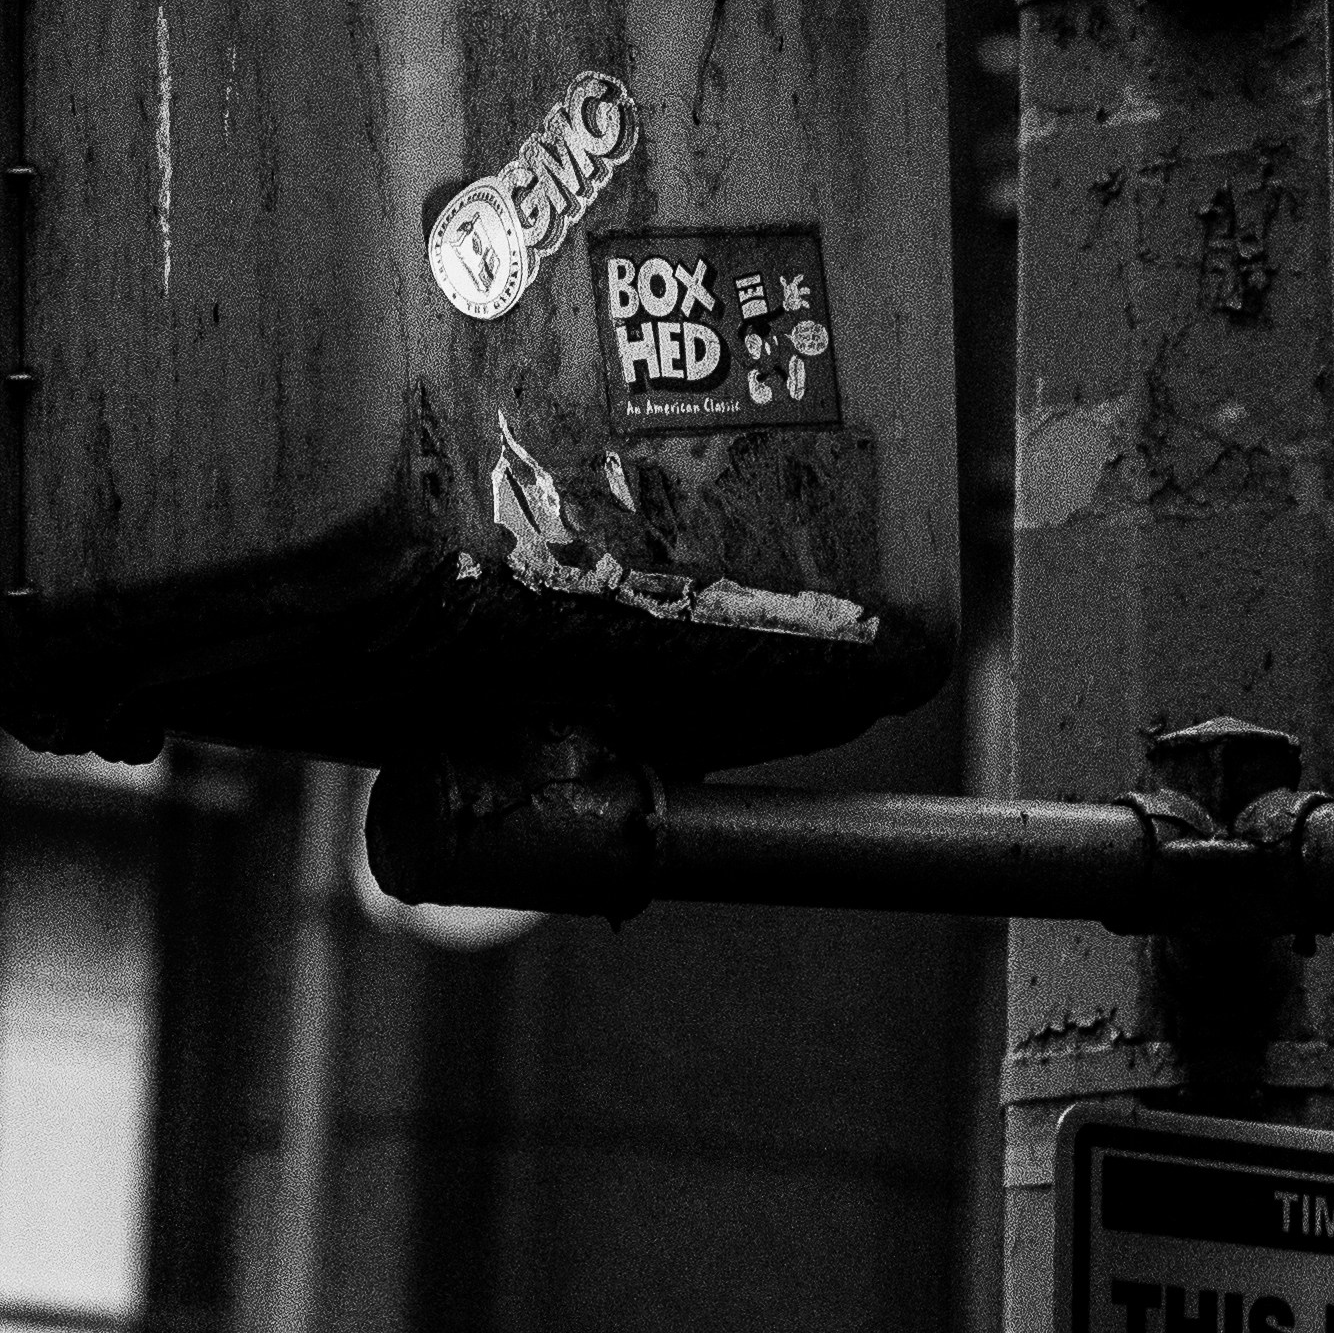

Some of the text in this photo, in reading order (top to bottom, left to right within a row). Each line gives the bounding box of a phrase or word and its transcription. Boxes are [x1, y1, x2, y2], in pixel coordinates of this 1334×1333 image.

[607, 257, 717, 319] BOX
[616, 321, 721, 383] HED
[626, 401, 641, 415] An
[646, 399, 700, 416] American
